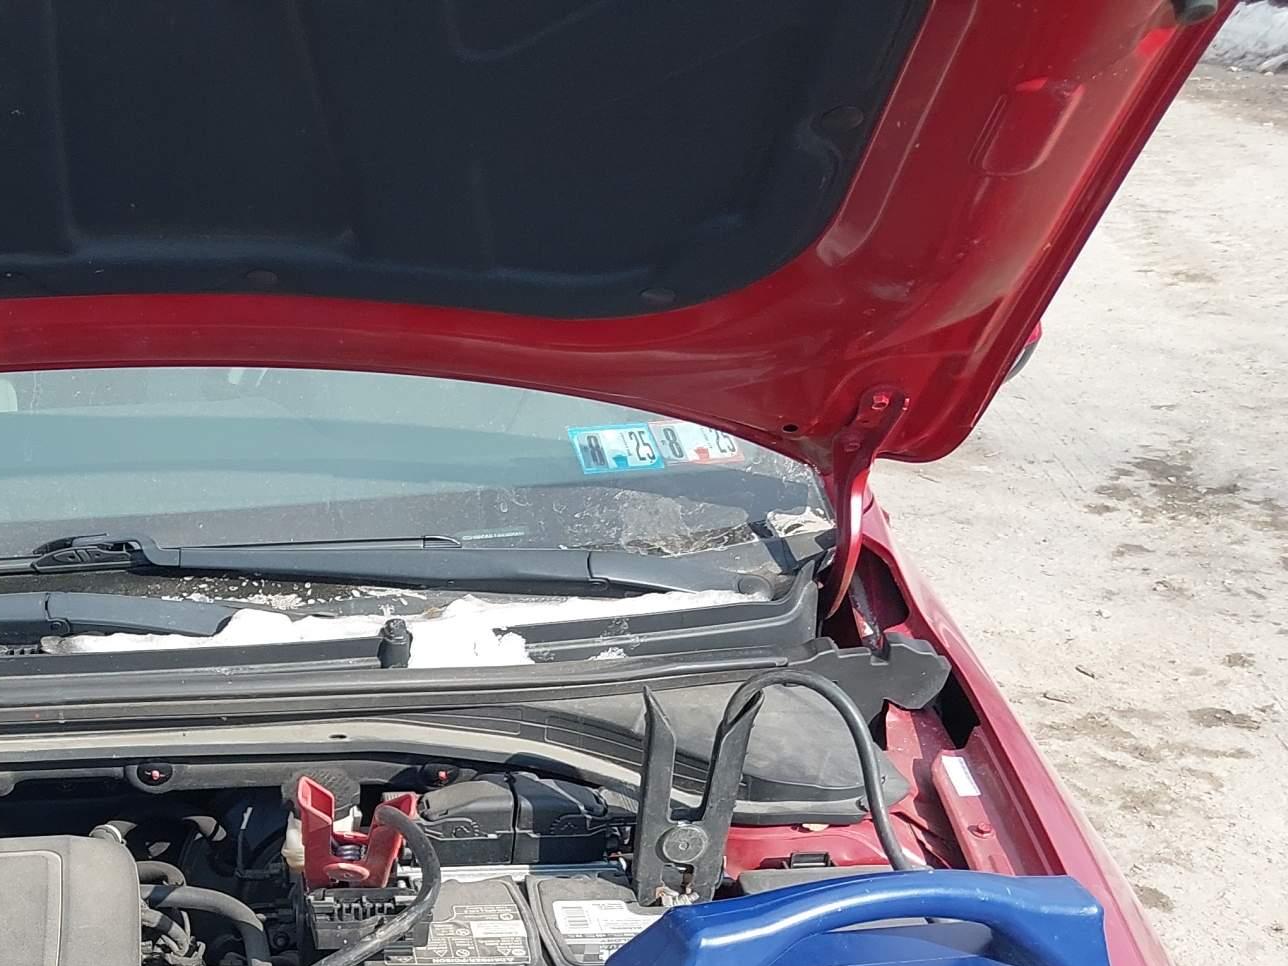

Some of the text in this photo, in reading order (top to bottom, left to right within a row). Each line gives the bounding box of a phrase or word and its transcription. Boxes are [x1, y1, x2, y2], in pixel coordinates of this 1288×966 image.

[628, 430, 657, 462] 25
[663, 427, 737, 459] 8 25
